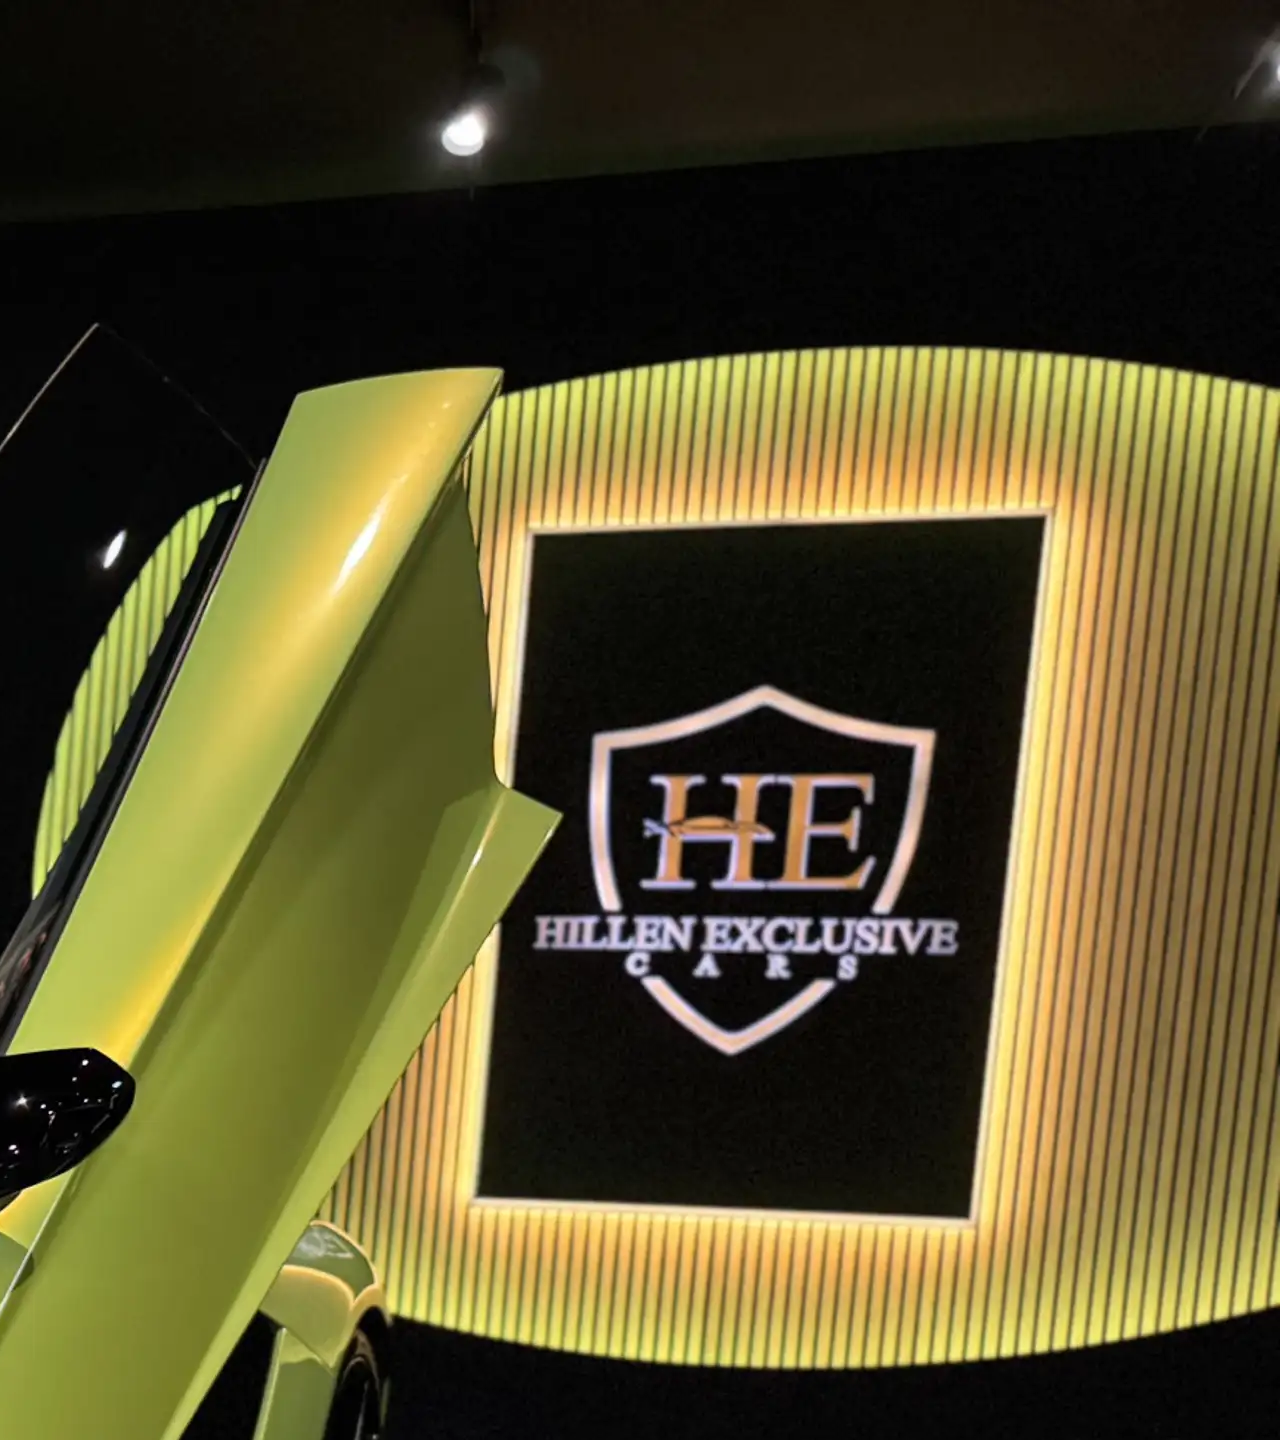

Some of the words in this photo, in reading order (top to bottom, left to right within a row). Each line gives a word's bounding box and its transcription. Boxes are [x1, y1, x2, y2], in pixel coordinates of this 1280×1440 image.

[640, 773, 876, 890] HE
[533, 914, 697, 951] HILLEN
[699, 915, 959, 956] EXCLUSIVE
[624, 952, 859, 979] CARS
